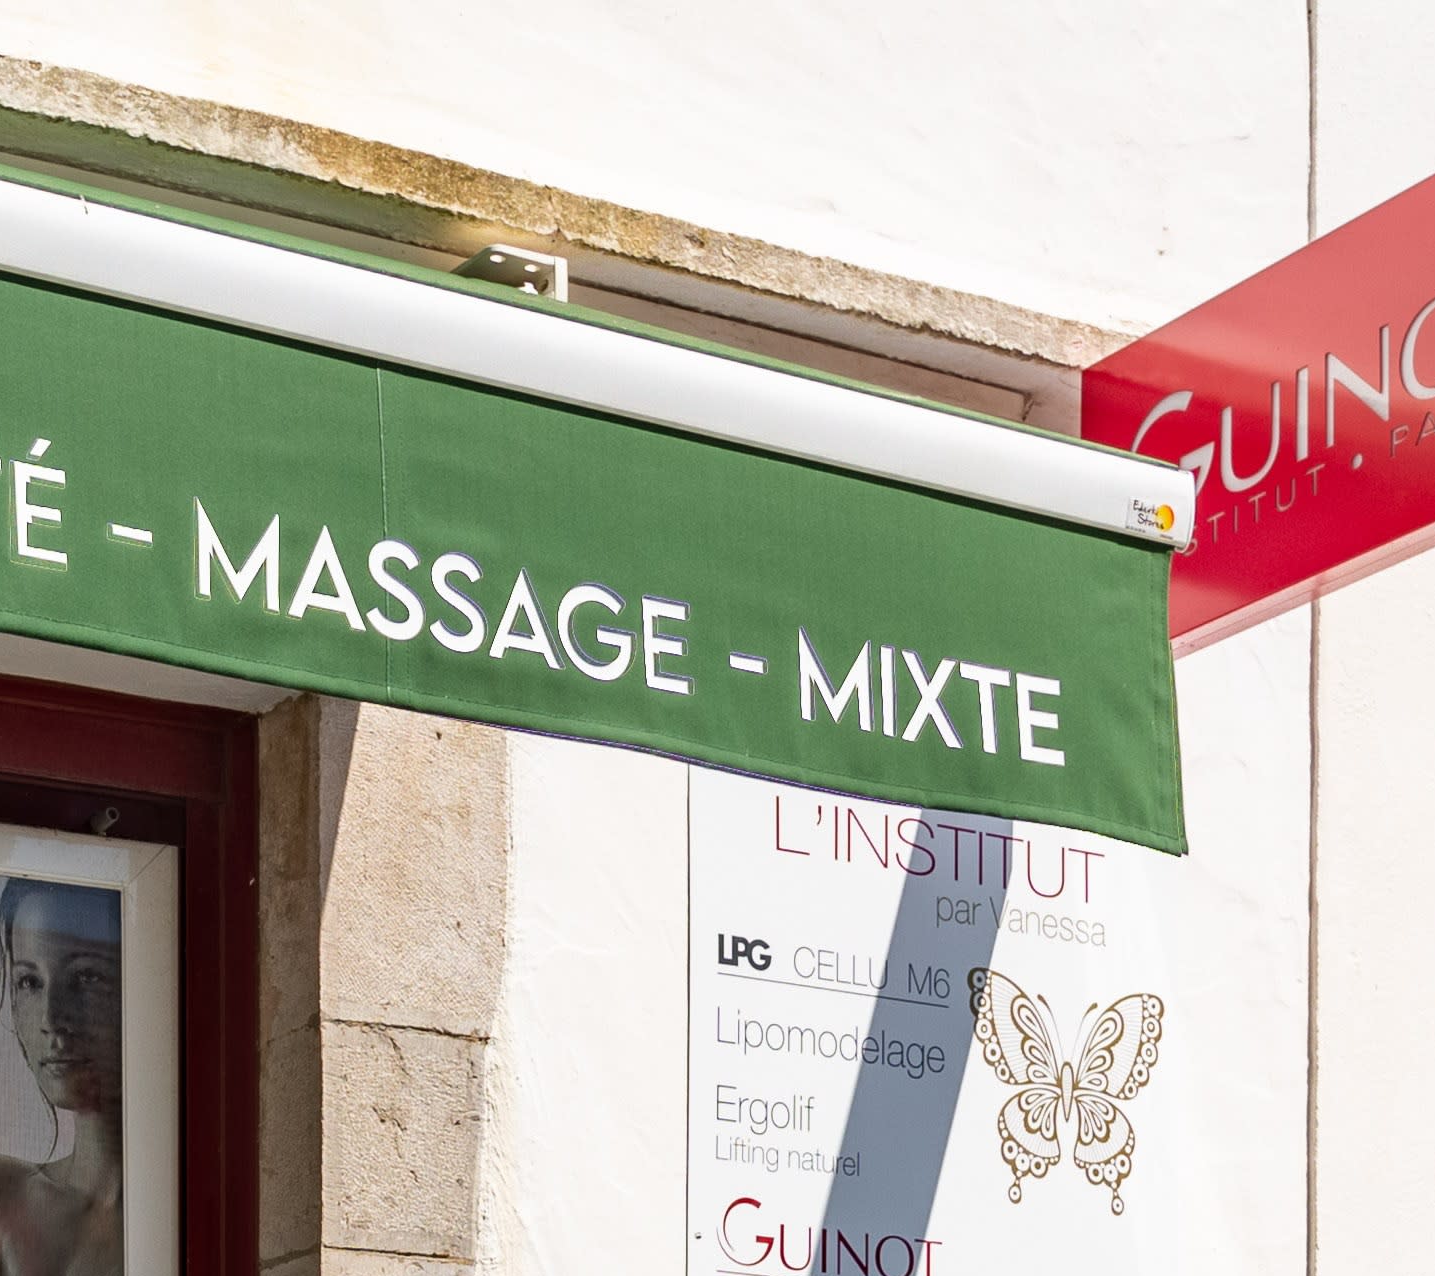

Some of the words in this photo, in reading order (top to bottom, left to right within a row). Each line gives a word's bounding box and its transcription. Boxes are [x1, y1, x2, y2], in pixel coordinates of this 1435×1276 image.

[191, 497, 695, 696] MASSAGE
[798, 625, 1067, 768] MIXTE
[775, 796, 1106, 903] L'INSTITUT
[936, 896, 981, 928] par
[989, 897, 1107, 947] Vanessa
[718, 933, 772, 971] LPG
[793, 946, 889, 990] CELLU
[908, 963, 951, 999] M6
[717, 1006, 945, 1080] Lipomodelage
[717, 1085, 815, 1135] Ergolif
[716, 1136, 780, 1172] Lifting
[787, 1150, 861, 1177] naturel
